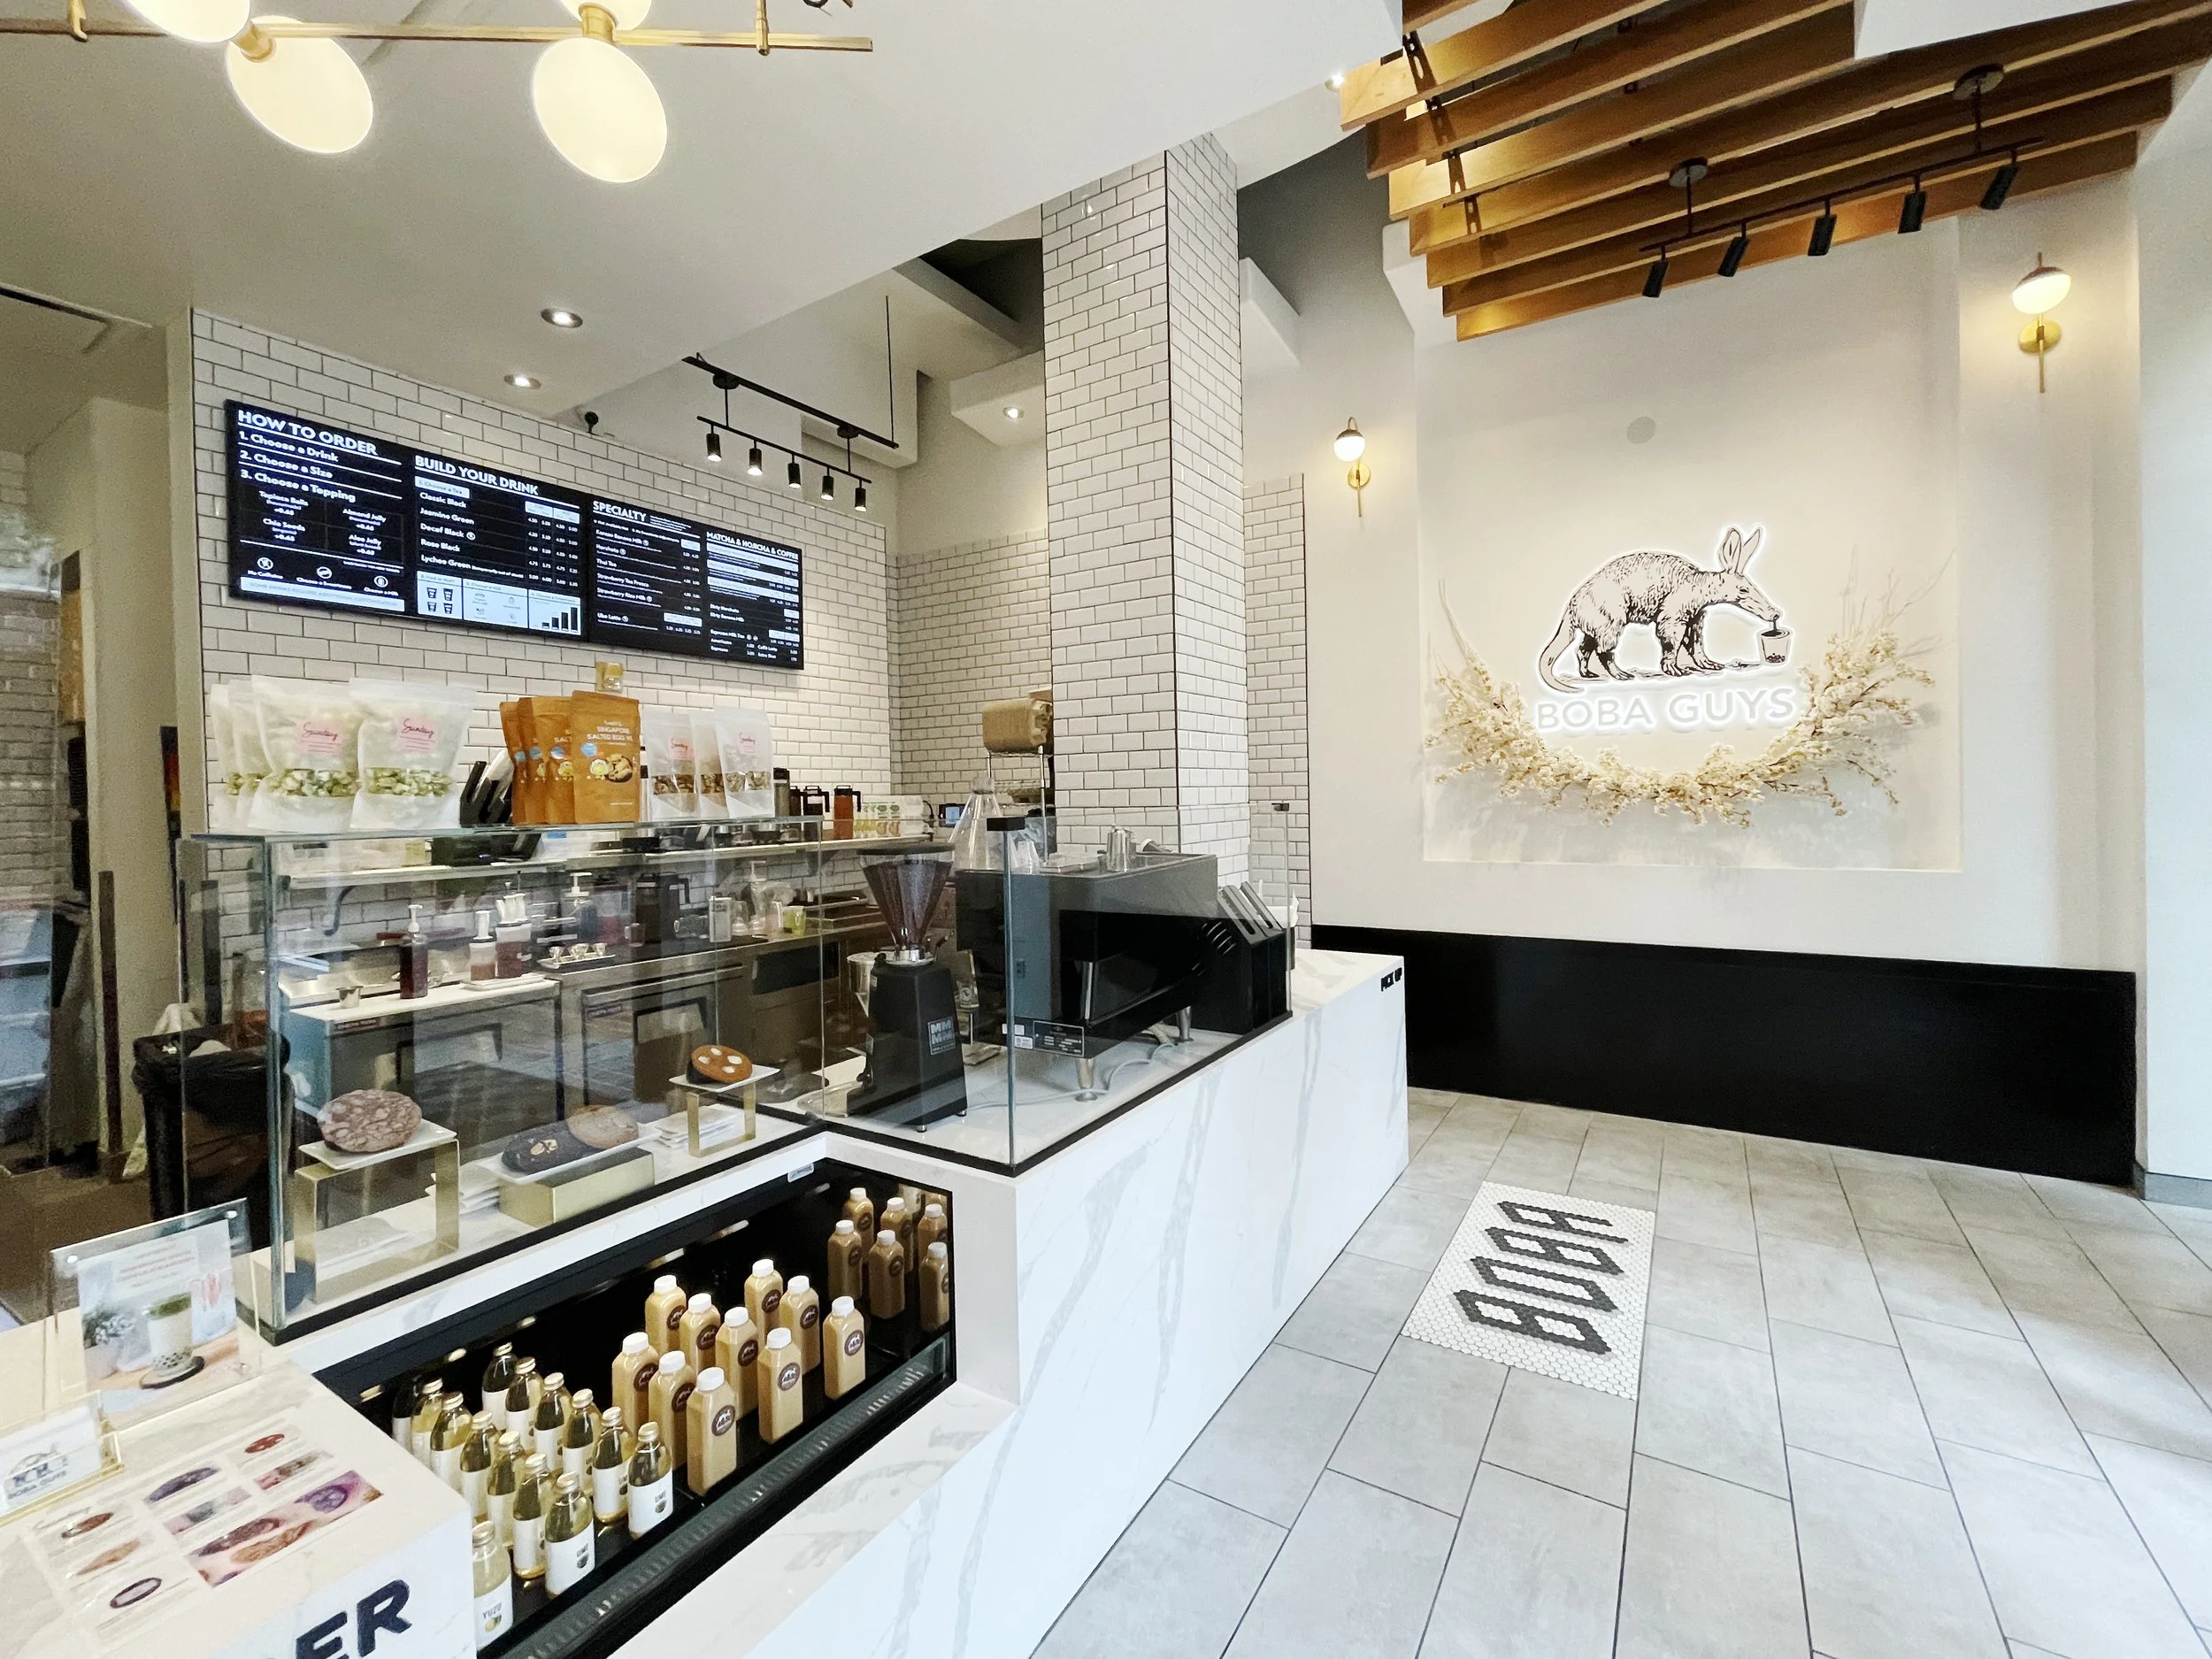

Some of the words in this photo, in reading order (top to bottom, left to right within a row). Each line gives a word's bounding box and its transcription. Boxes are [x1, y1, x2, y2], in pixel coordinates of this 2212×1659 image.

[238, 411, 286, 432] HOW
[288, 423, 316, 439] TO
[319, 432, 378, 456] ORDER
[239, 431, 248, 441] 1.
[250, 434, 296, 451] Choose
[307, 448, 338, 462] Drink
[240, 450, 251, 460] 2.
[254, 453, 298, 471] Choose
[310, 466, 333, 479] Size
[415, 455, 456, 474] BUILD
[458, 466, 497, 486] YOUR
[500, 477, 538, 495] DRINK
[240, 469, 252, 480] 3.
[255, 472, 299, 489] Choose
[310, 484, 356, 503] Topping
[419, 492, 446, 503] Classic
[447, 498, 466, 508] Black
[593, 501, 646, 522] SPECIALTY
[419, 508, 450, 519] Jasmine
[451, 514, 474, 525] Green
[420, 523, 443, 534] Decaf
[445, 526, 464, 538] Black
[421, 539, 439, 549] Rose
[441, 542, 460, 553] Black
[707, 531, 735, 544] MATCHA
[742, 541, 770, 553] HOJICHA
[777, 549, 798, 560] COFFEE
[421, 555, 447, 566] Lychee
[449, 557, 471, 569] Green
[597, 572, 624, 583] Strawberry
[597, 588, 624, 597] Strawberry
[1537, 697, 1654, 729] BOBA
[1669, 688, 1794, 723] GUYS
[1453, 1202, 1628, 1355] BOBA
